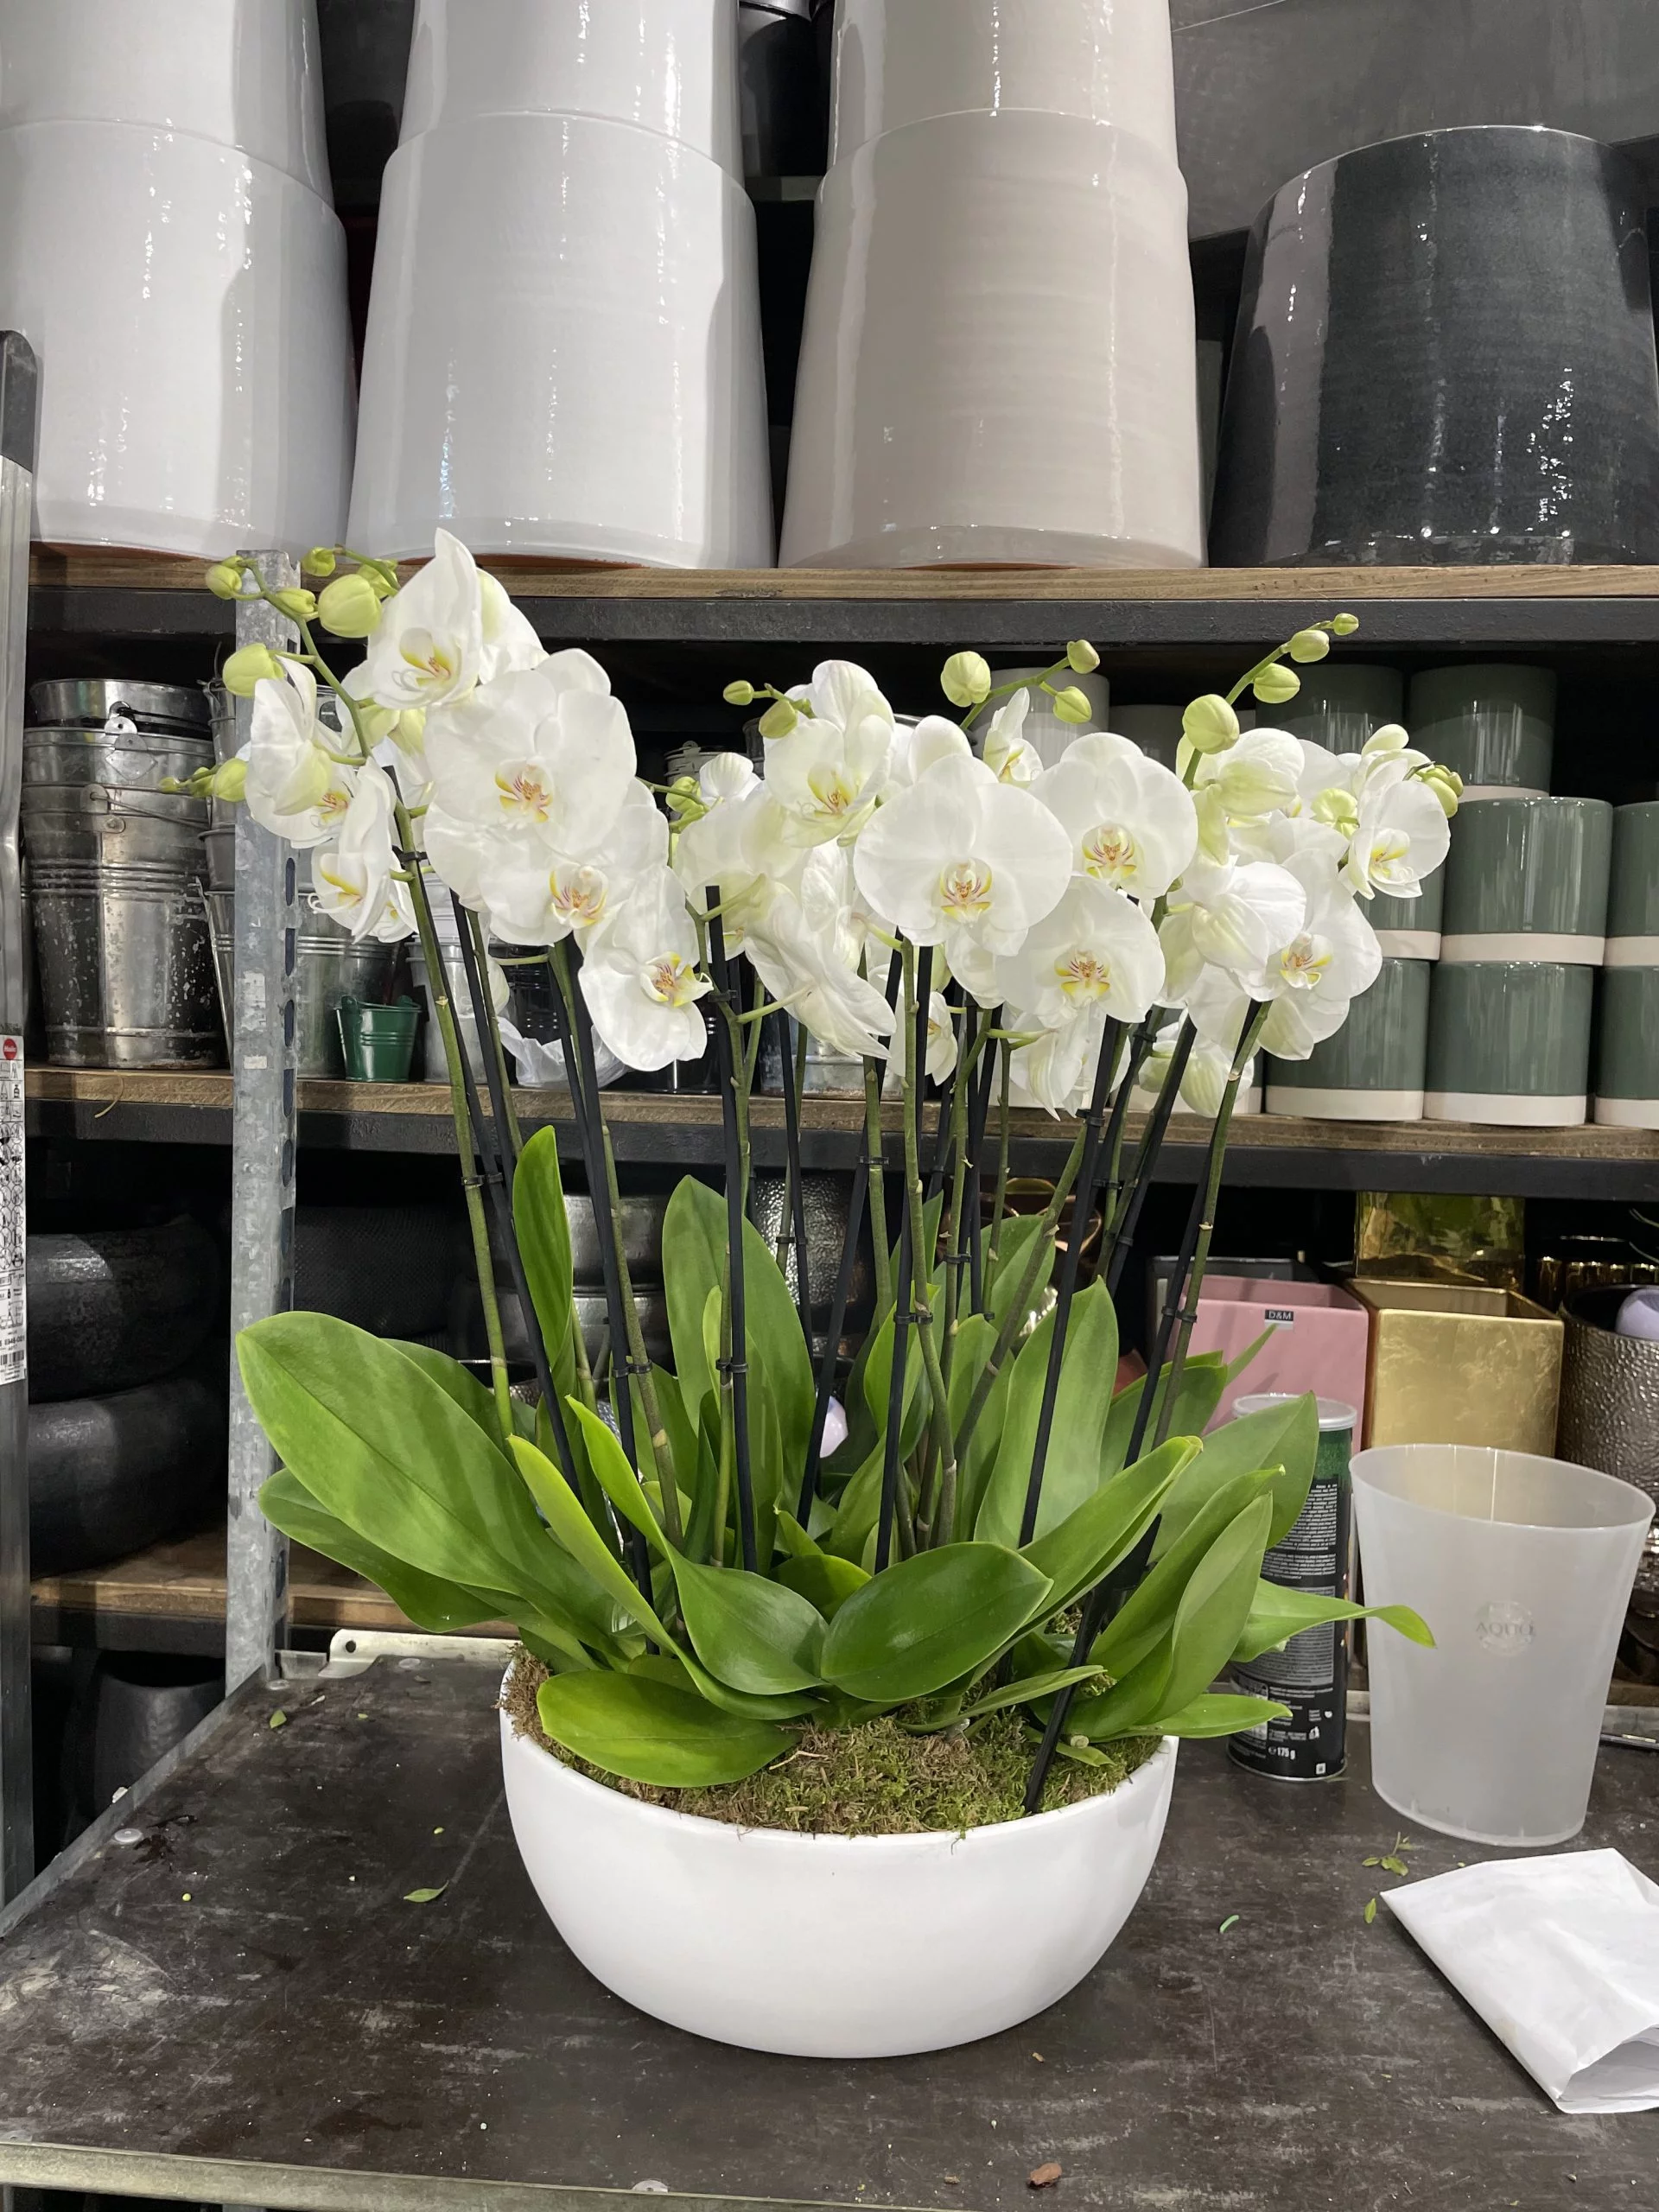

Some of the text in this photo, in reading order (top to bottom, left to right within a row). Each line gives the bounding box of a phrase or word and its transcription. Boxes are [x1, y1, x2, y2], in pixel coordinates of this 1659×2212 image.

[1268, 1310, 1292, 1320] D&M
[1277, 1746, 1289, 1758] 175
[1290, 1750, 1296, 1760] g
